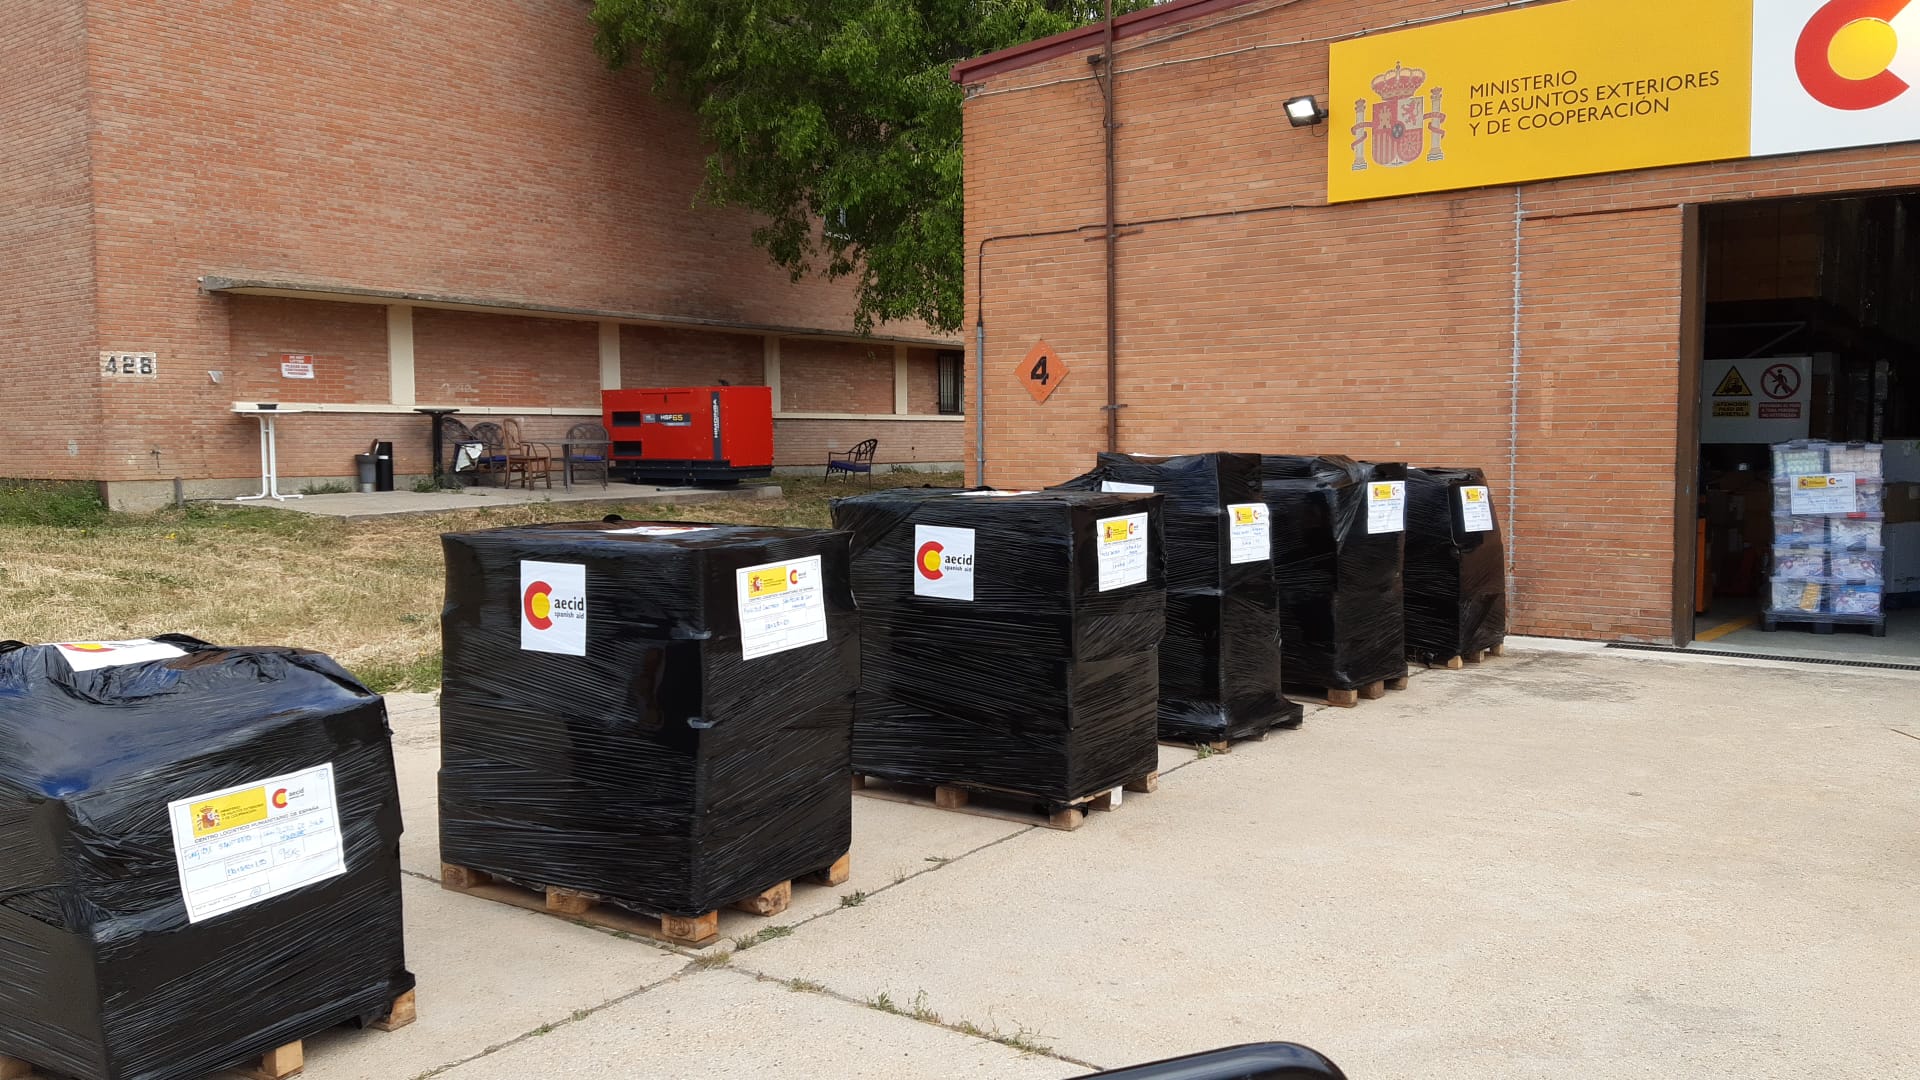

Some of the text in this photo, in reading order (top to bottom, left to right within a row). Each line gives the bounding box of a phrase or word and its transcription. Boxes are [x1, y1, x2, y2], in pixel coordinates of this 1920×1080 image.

[1470, 70, 1577, 99] MINISTERIO
[1470, 70, 1720, 118] DE ASUNTOS EXTERIORES
[1469, 96, 1669, 137] Y DE COOPERACIÓN
[1030, 355, 1050, 386] 4
[945, 554, 972, 565] aecid
[554, 596, 584, 610] aecid
